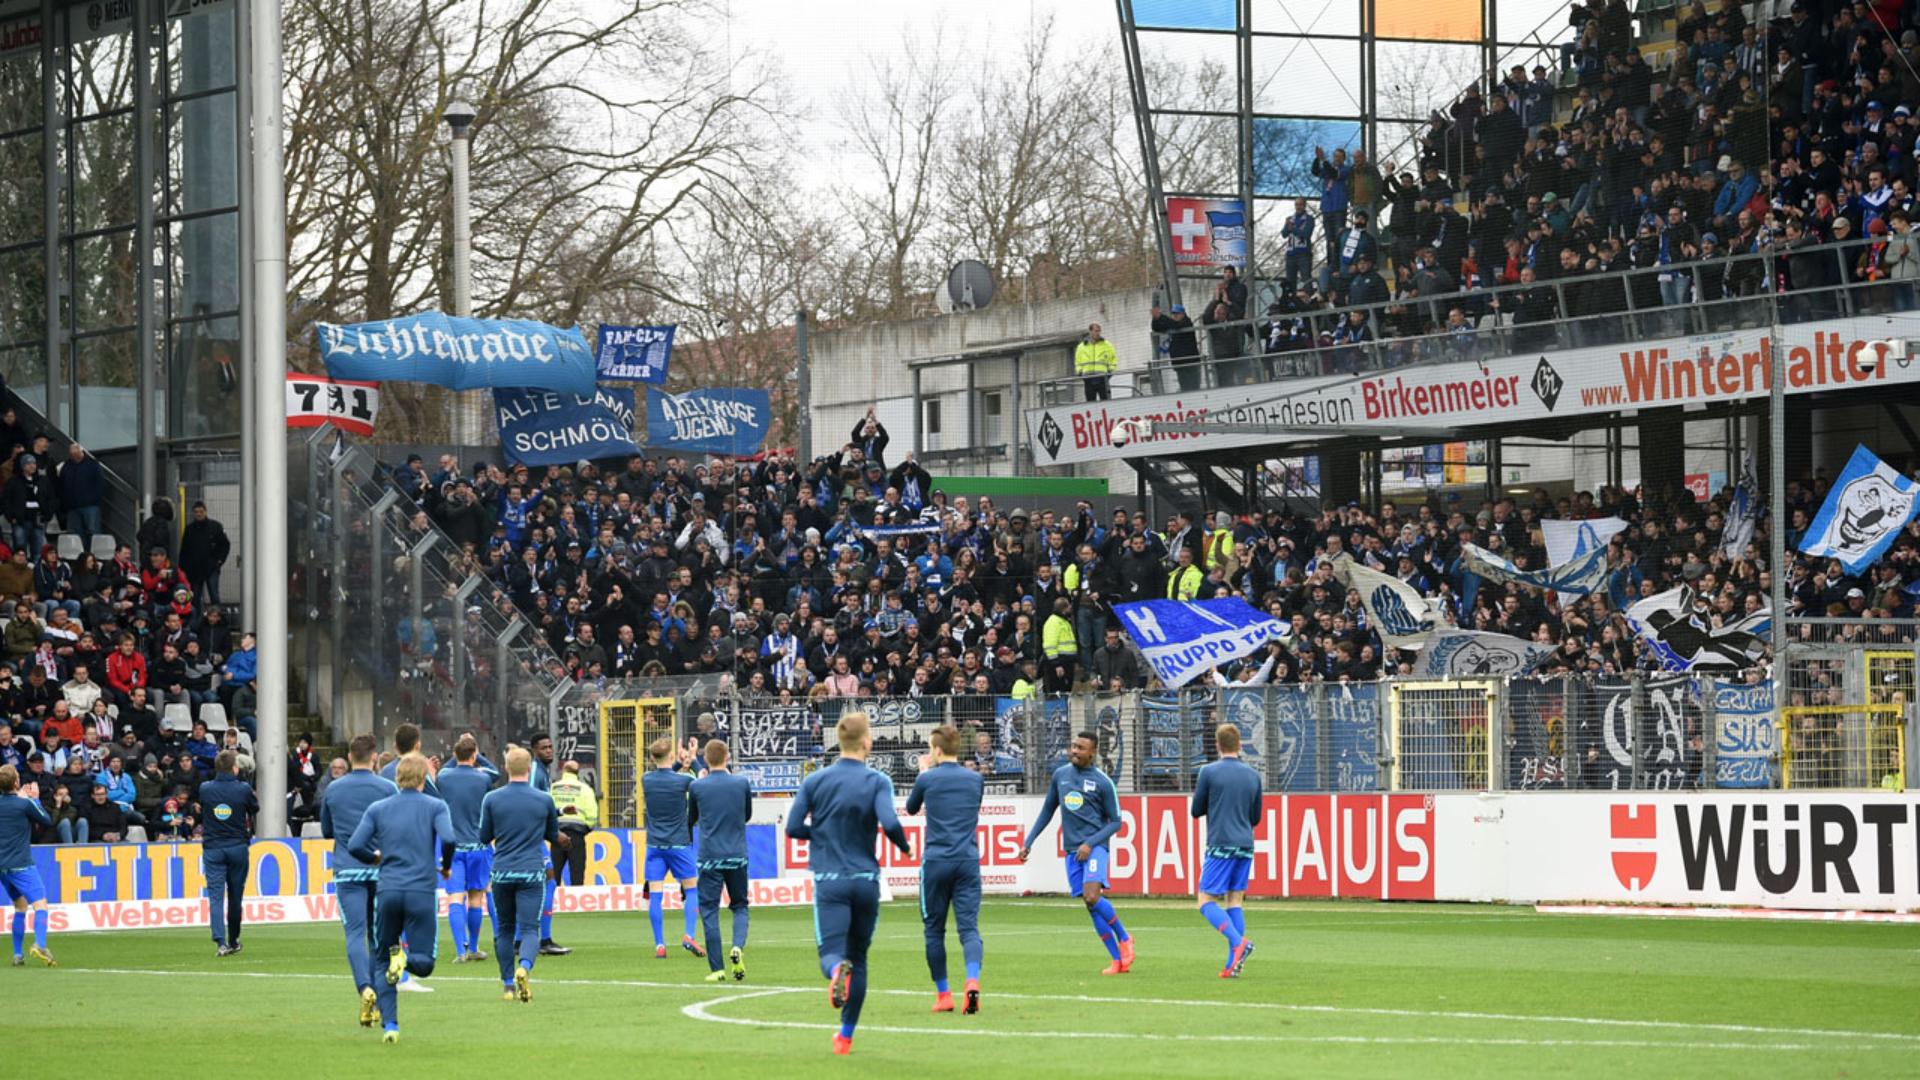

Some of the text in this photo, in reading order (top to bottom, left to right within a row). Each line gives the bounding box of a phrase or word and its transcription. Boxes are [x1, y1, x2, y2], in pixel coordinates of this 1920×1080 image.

[327, 321, 553, 364] Lichtenrade
[1361, 367, 1520, 420] Birkenmeier
[500, 392, 562, 429] ALTE
[1151, 637, 1226, 681] GRUPPO
[714, 711, 811, 731] RGAZZI
[862, 700, 922, 726] BSC
[727, 736, 798, 757] URVA
[749, 777, 799, 788] ACHSEN
[1109, 808, 1429, 885] BAHAUS
[1674, 803, 1920, 896] WÜRT
[1088, 859, 1098, 873] 8
[88, 900, 286, 929] Weberaus
